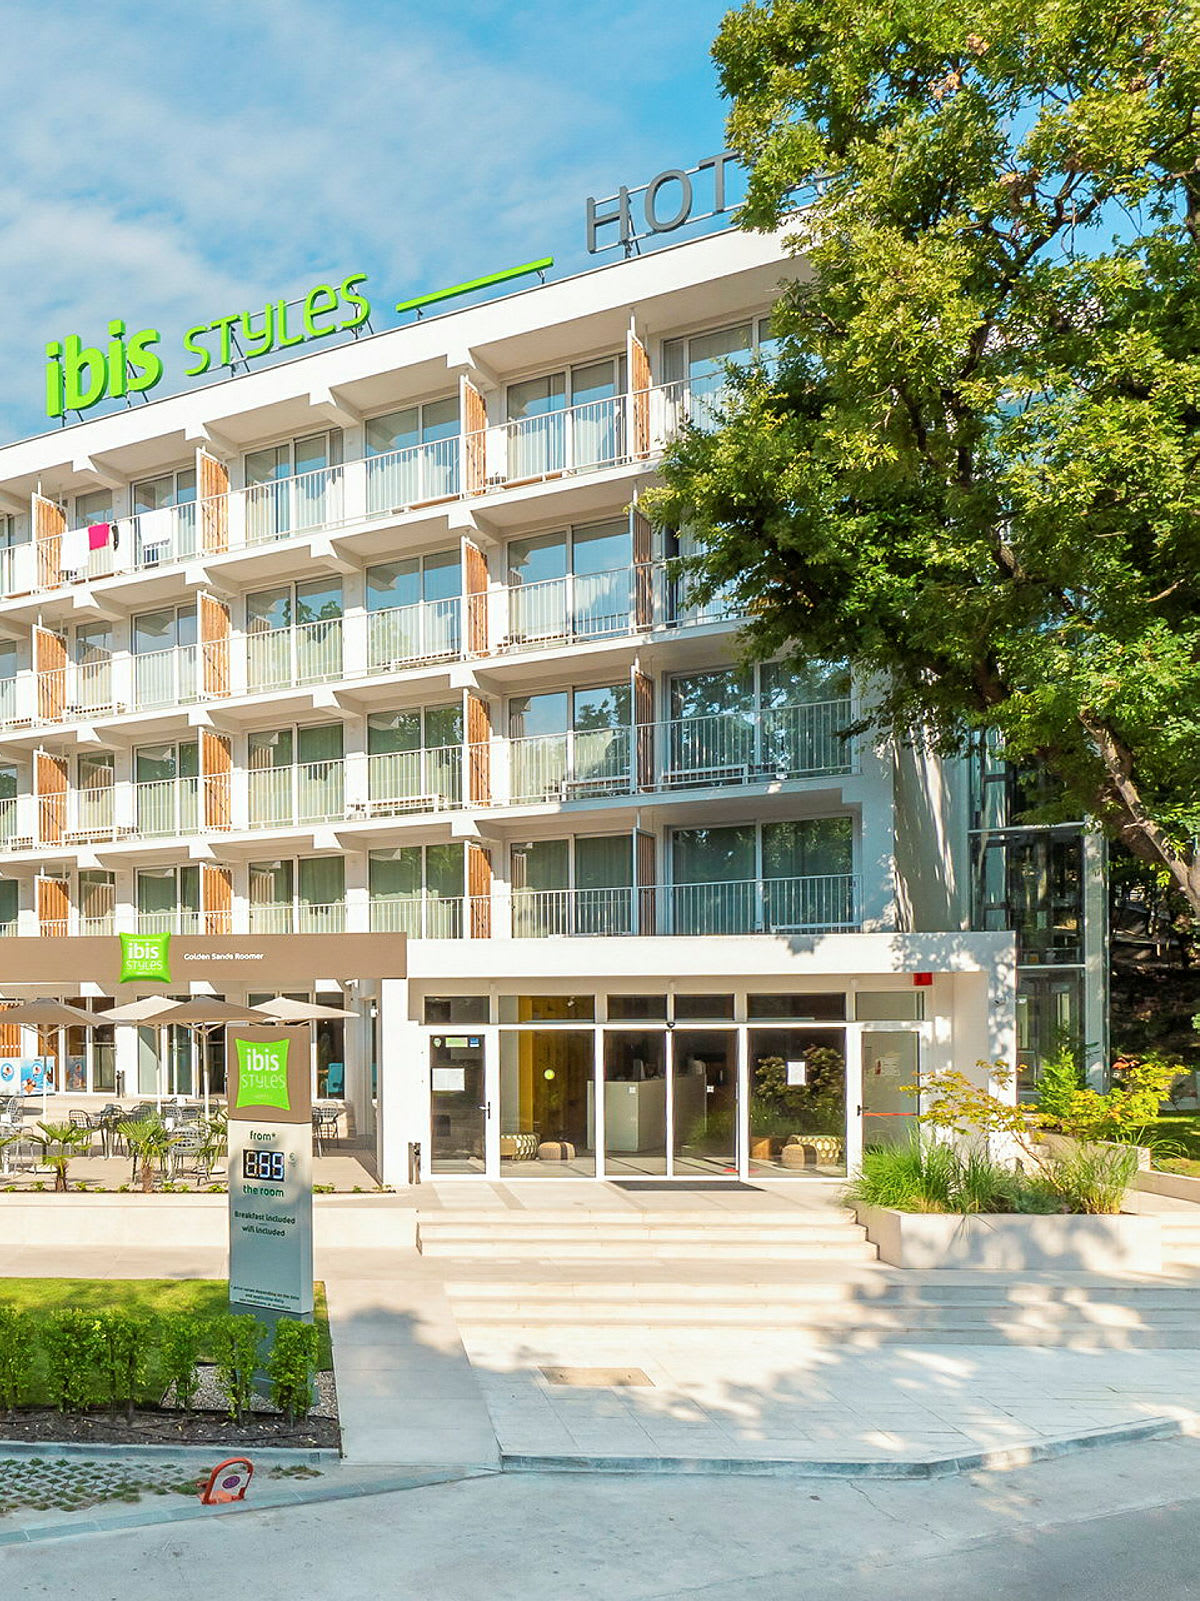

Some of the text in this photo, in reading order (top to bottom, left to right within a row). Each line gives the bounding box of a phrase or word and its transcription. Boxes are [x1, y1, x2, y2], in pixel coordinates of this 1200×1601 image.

[586, 149, 745, 254] HOT
[45, 319, 164, 418] ibis
[127, 942, 159, 959] ibis
[235, 952, 264, 960] Roomer
[246, 1048, 279, 1071] ibis
[243, 1184, 284, 1198] the room
[234, 1210, 296, 1224] Breakfast included
[255, 1226, 285, 1237] included
